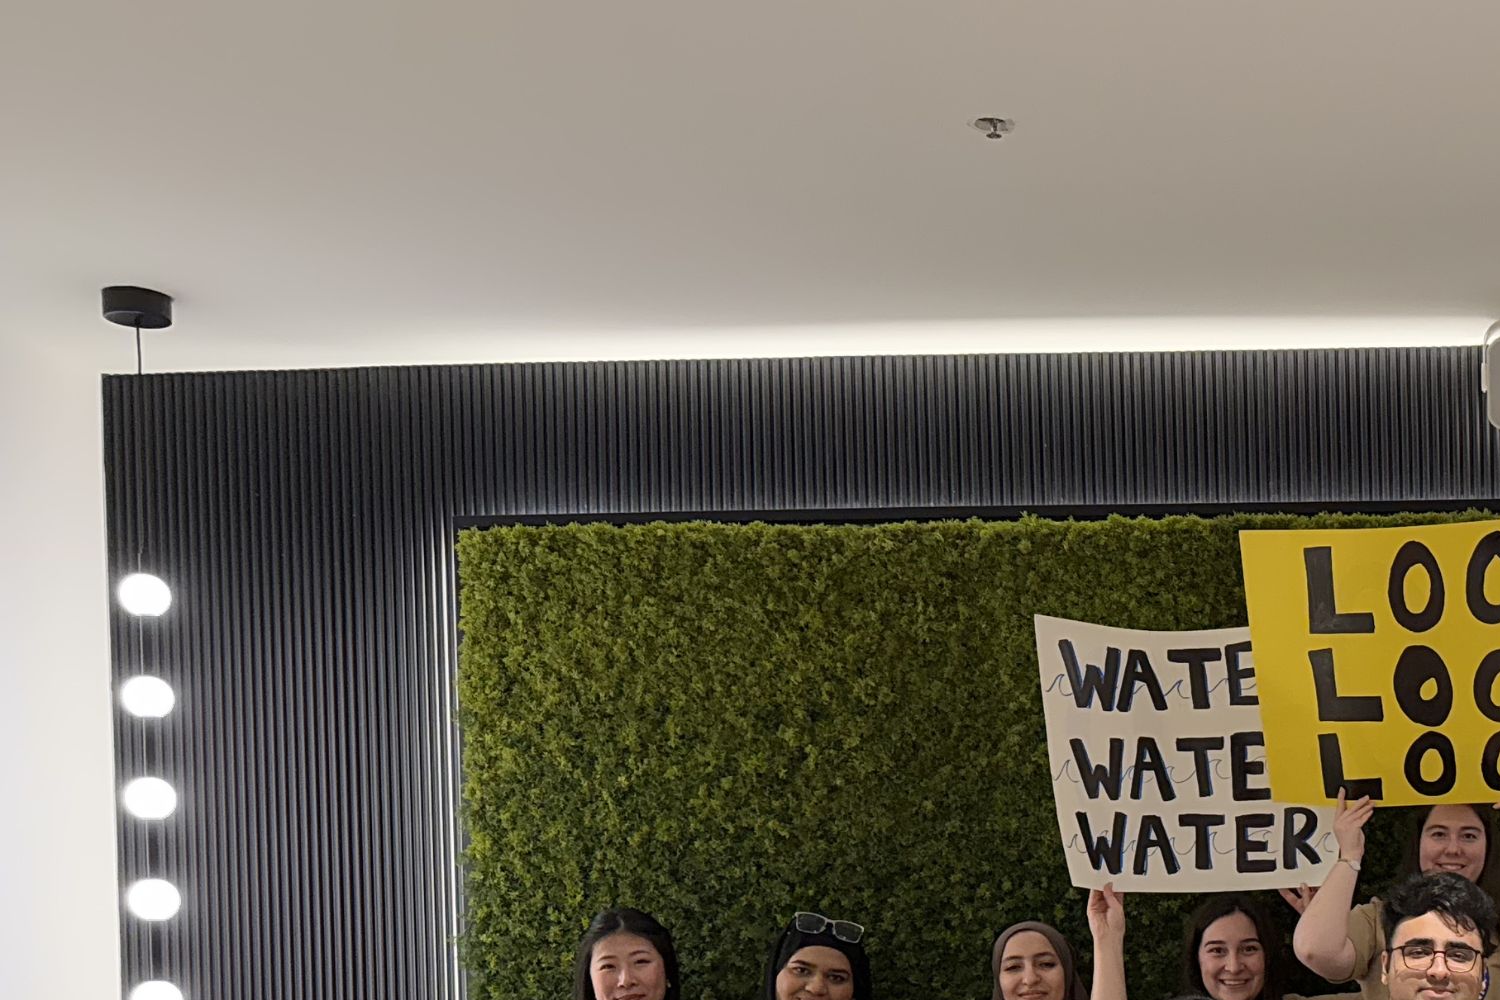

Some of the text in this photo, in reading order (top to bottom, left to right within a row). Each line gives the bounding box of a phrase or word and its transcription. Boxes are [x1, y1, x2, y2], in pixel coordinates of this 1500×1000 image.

[1058, 640, 1259, 712] WATE
[1070, 731, 1271, 801] WATE
[1076, 806, 1321, 875] WATER
